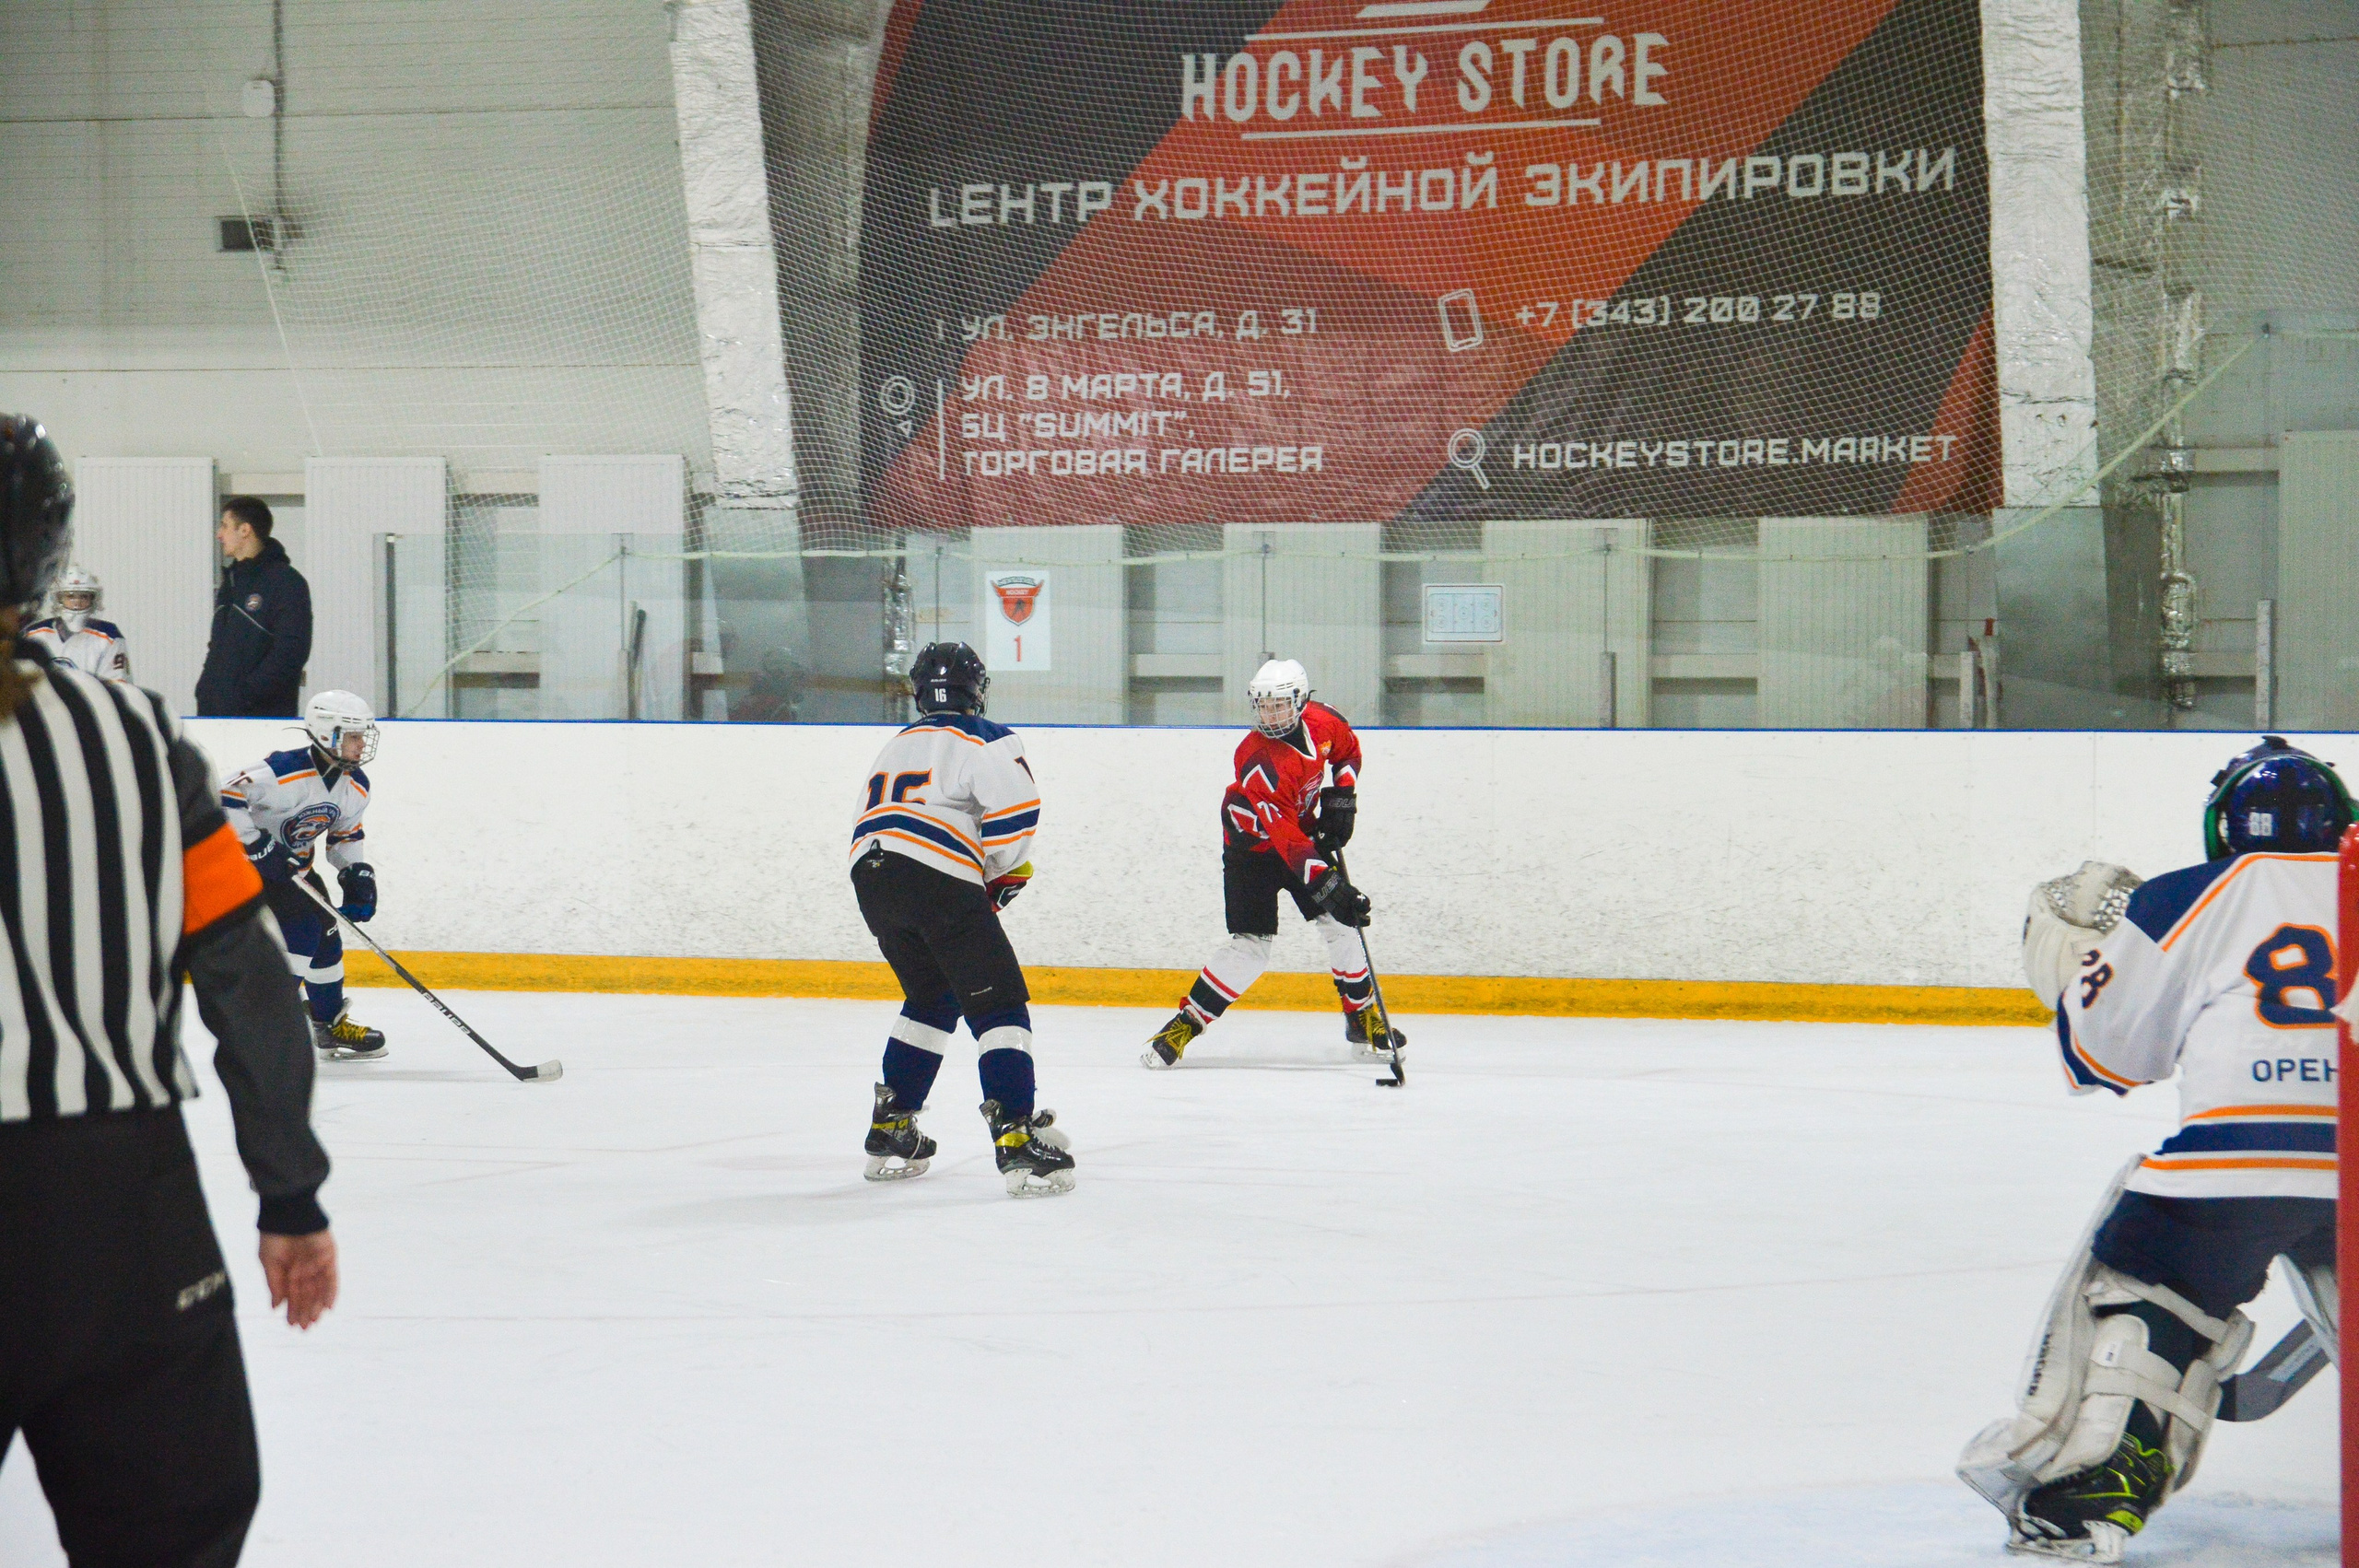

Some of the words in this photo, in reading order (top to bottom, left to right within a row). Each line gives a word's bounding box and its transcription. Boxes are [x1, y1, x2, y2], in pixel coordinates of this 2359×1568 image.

[1181, 44, 1428, 123] HOCKEY
[1457, 32, 1670, 112] STORE
[1133, 151, 1497, 221] ХОККЕЙНОЙ
[1525, 146, 1957, 206] ЭКИПИРОВКИ
[961, 313, 1015, 341] УЛ.
[1027, 310, 1225, 340] ЭНГЕЛЬСА,
[1282, 307, 1317, 334] 31
[1515, 300, 1558, 327] +7
[1684, 296, 1760, 323] 200
[1773, 294, 1819, 320] 27
[1832, 291, 1881, 319] 88
[961, 374, 1015, 401] УЛ.
[1027, 374, 1050, 401] 8
[1062, 371, 1191, 401] МАРТА,
[1203, 370, 1236, 401] Д.
[1248, 370, 1291, 399] 51,
[962, 412, 1006, 443] БЦ
[962, 449, 1147, 476] ТОРГОВАЯ
[1160, 446, 1323, 474] ГАЛЕРЕЯ
[1513, 435, 1957, 470] HOCKEYSTORE.MARKET
[1014, 635, 1022, 662] 1
[934, 687, 947, 703] 16
